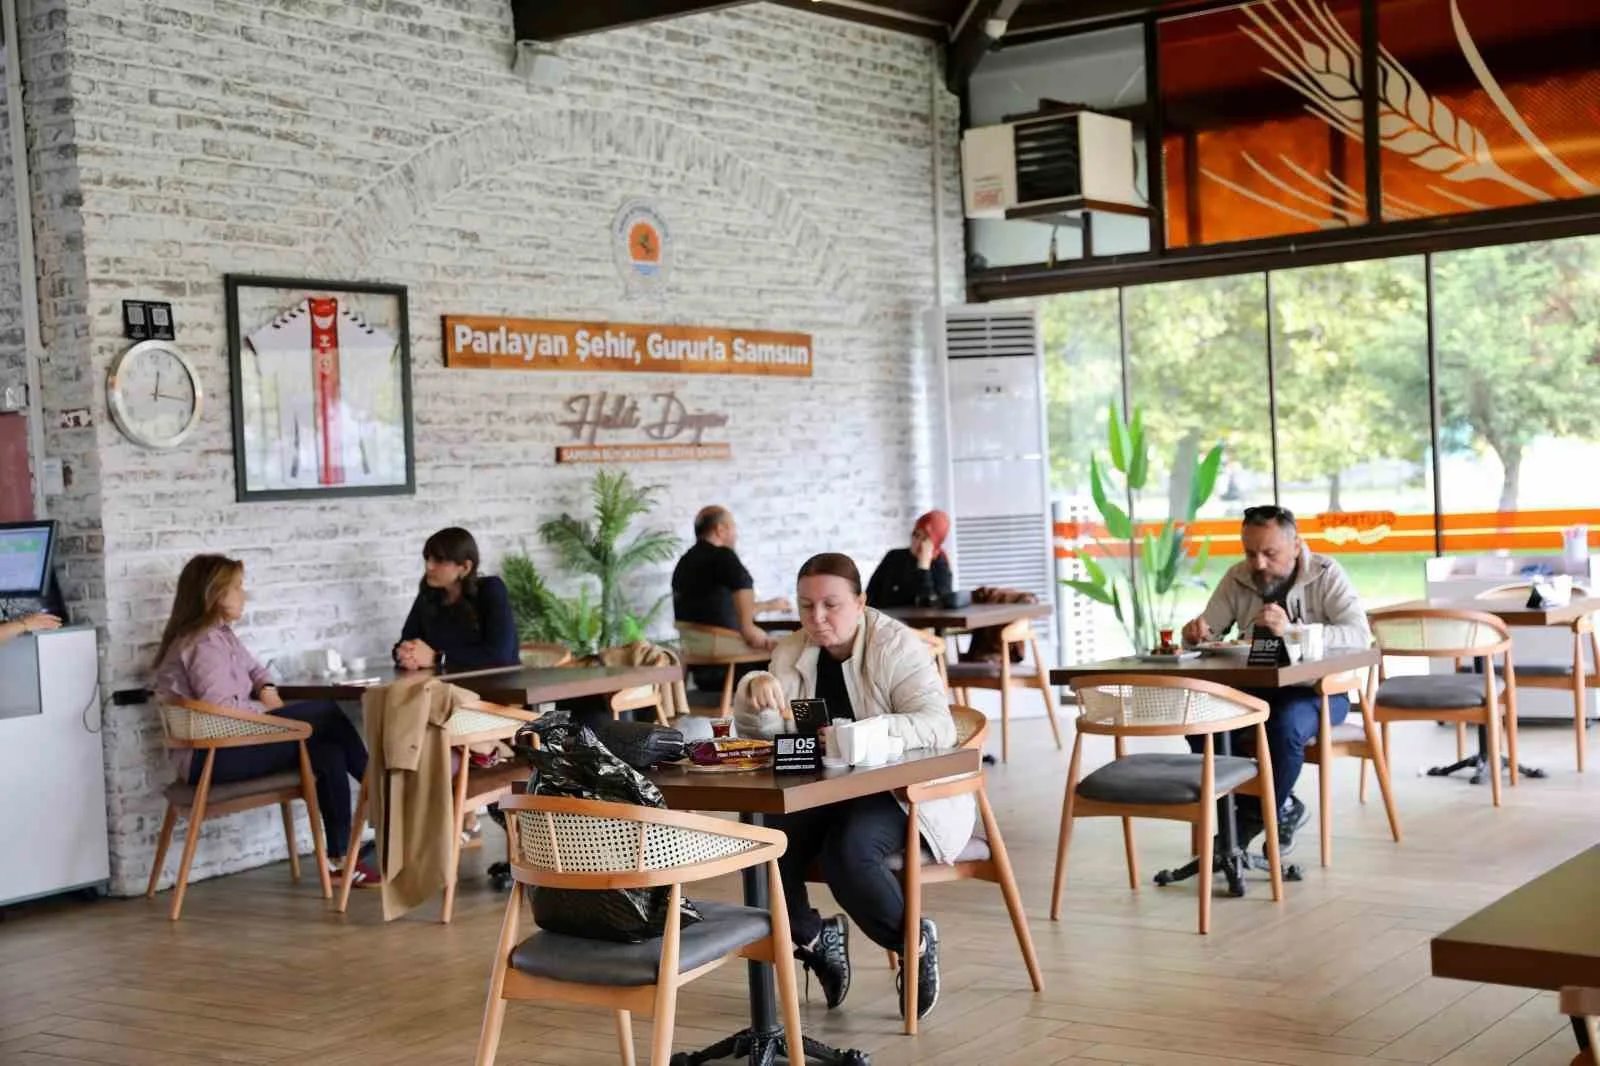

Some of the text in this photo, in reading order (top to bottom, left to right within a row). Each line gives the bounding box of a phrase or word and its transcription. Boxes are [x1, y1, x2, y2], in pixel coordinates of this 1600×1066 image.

[454, 324, 809, 365] Parlayan Şehir, Gururla Samsun
[795, 737, 815, 749] 05
